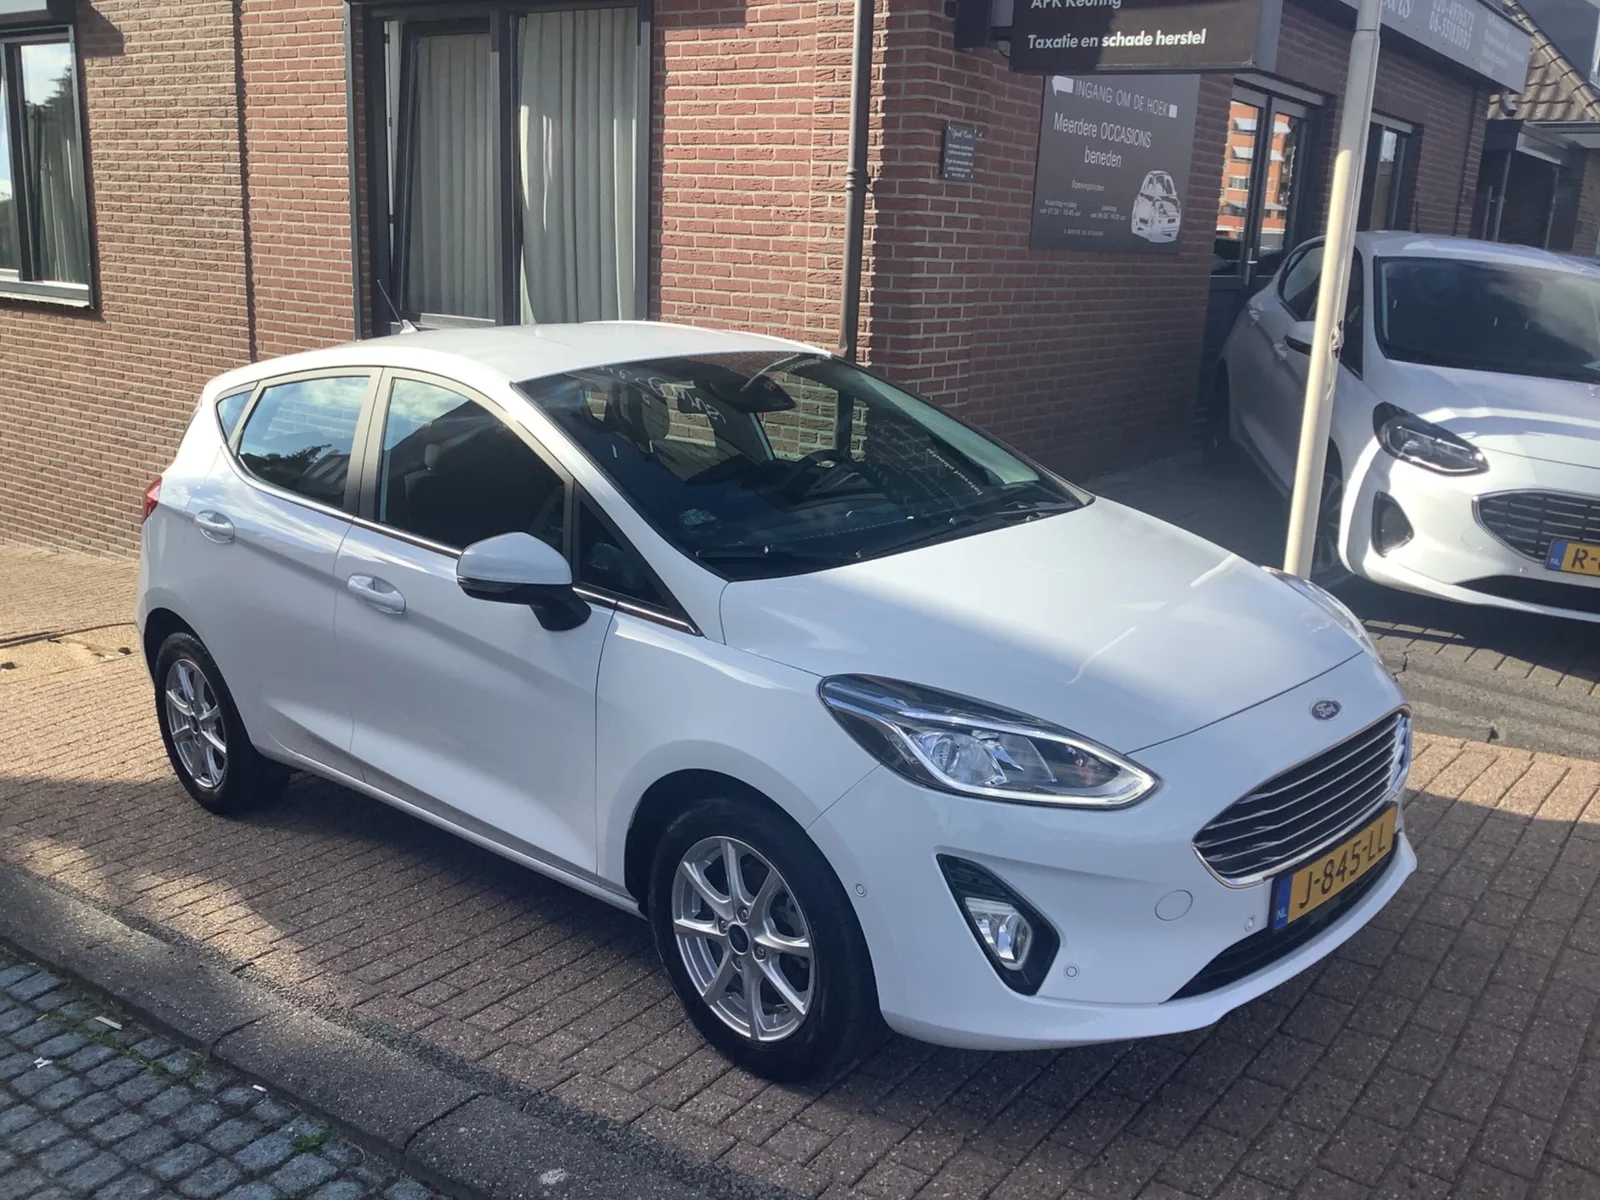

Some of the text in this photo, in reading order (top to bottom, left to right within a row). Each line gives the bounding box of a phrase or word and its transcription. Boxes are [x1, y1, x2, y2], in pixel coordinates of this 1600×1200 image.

[1030, 0, 1063, 9] APK
[1028, 28, 1207, 49] Taxatie en schade herstel
[1075, 80, 1168, 117] INGANG OM DE HOEK
[1053, 112, 1152, 148] Meerdere OCCASIONS
[1084, 145, 1122, 168] beneden
[1571, 548, 1600, 571] R-
[1299, 822, 1386, 909] J-845-LL
[1276, 907, 1287, 921] NL
